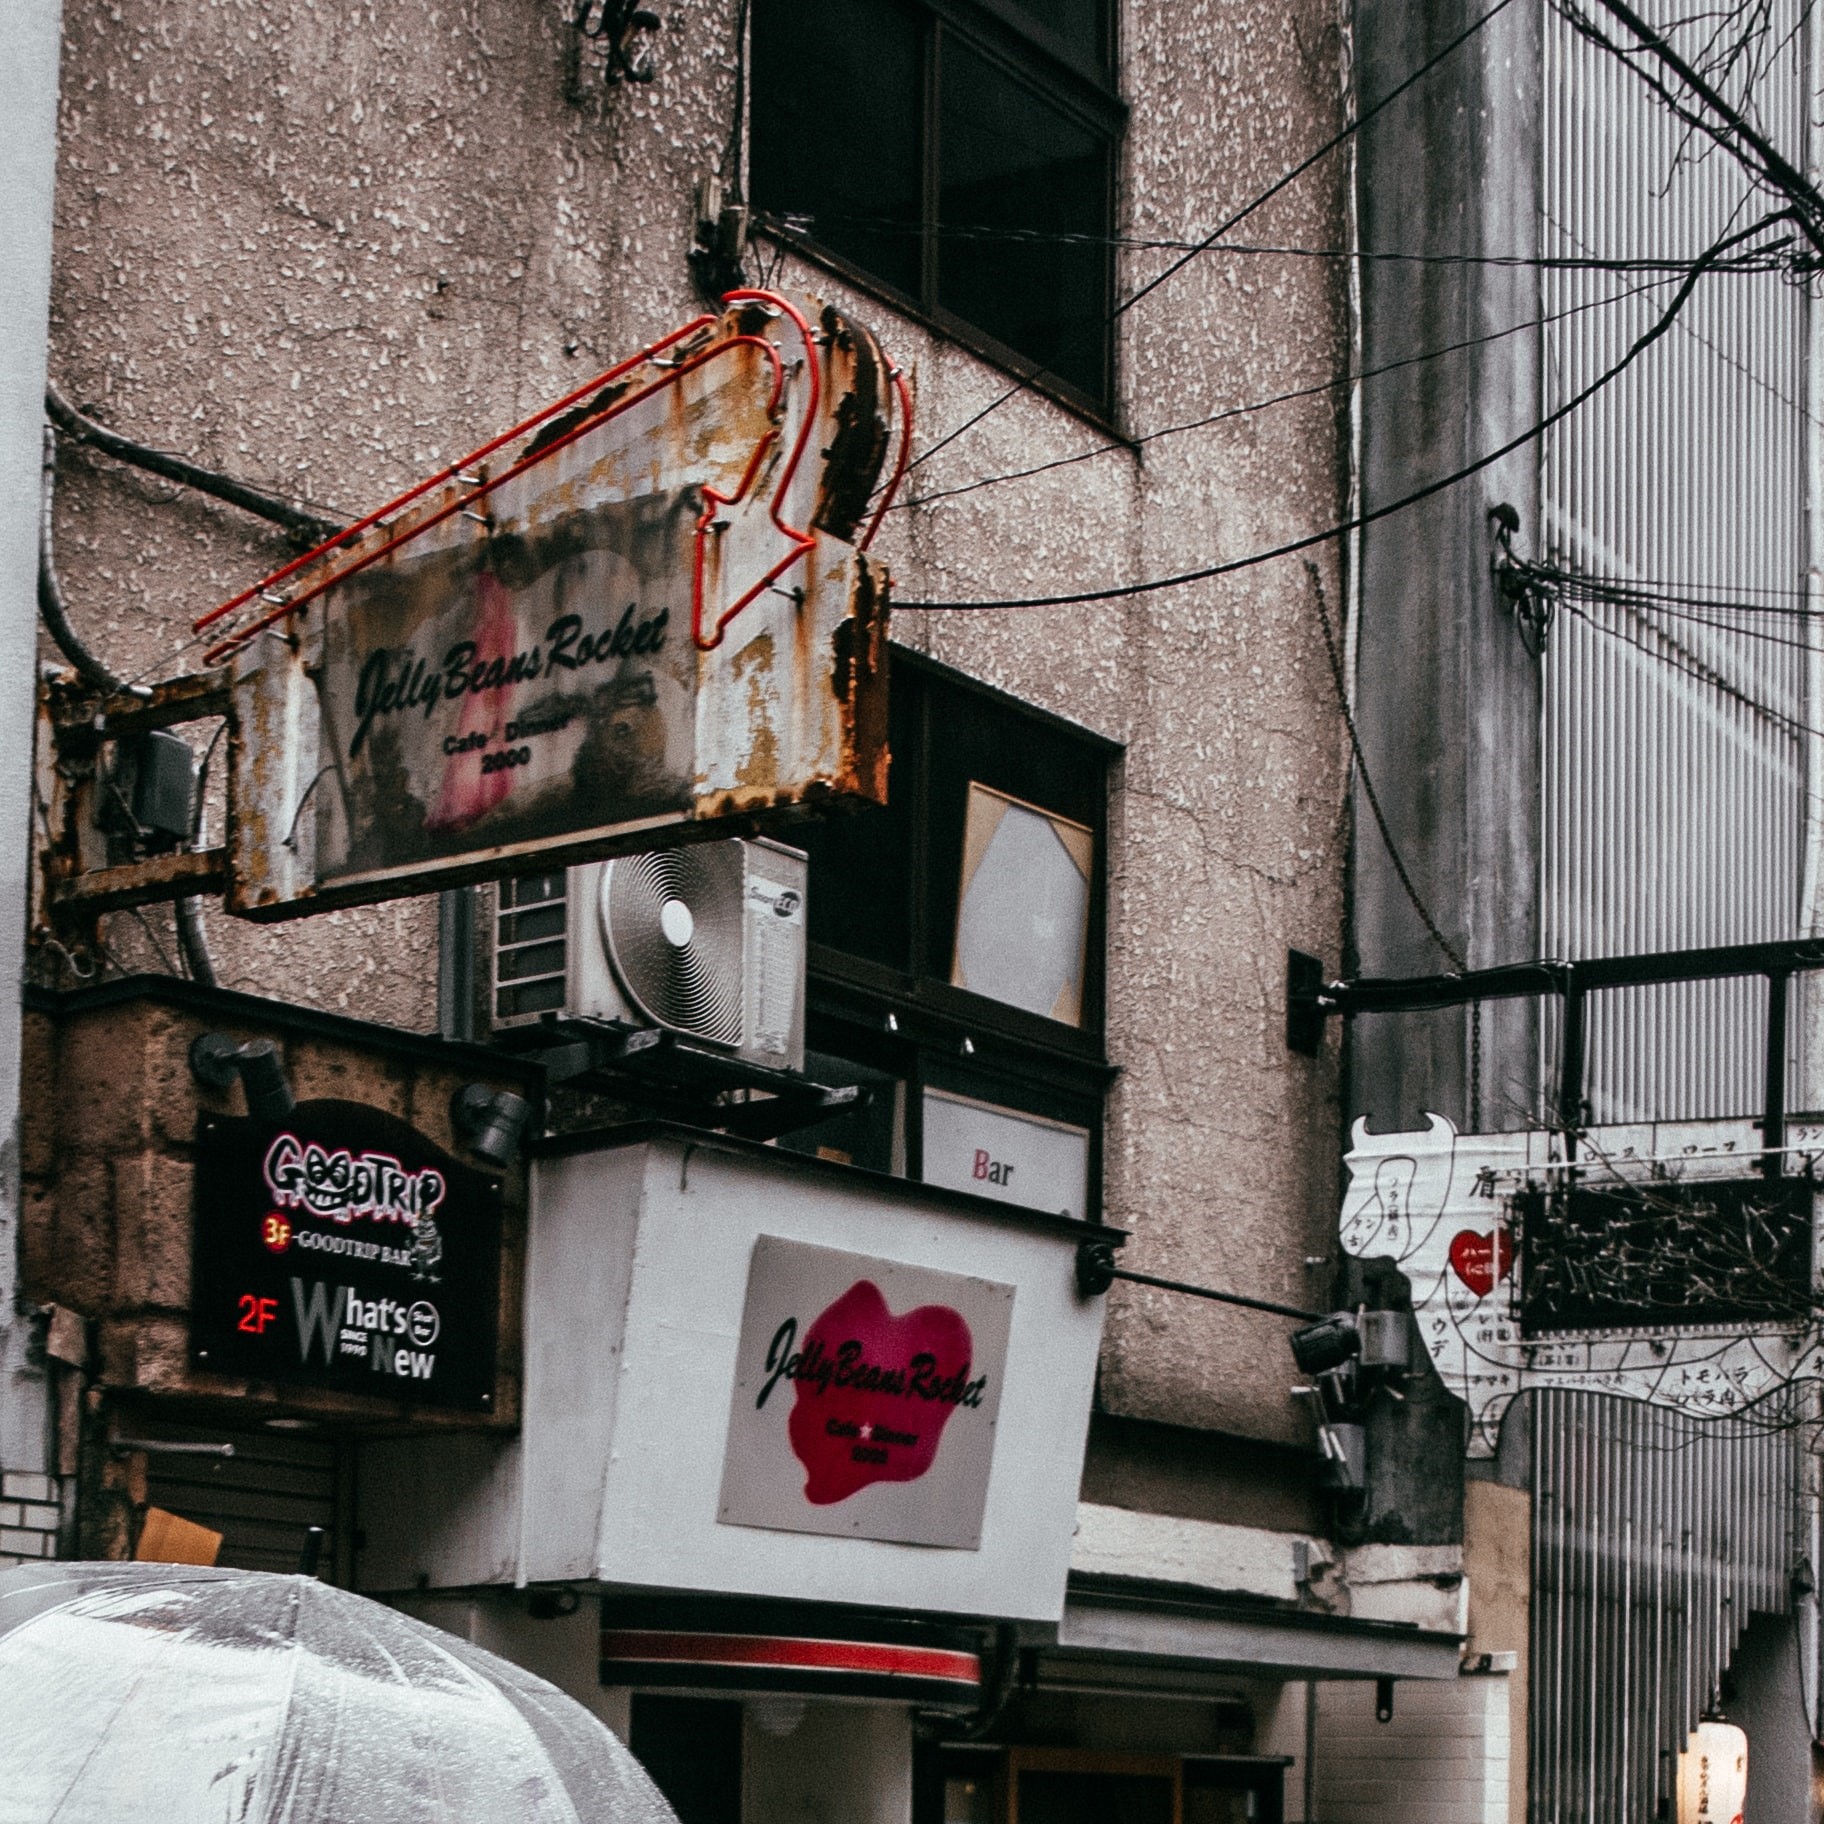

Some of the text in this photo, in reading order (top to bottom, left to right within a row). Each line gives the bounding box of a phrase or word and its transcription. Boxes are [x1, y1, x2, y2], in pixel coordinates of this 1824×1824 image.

[972, 1148, 1014, 1186] Bar
[264, 1217, 291, 1245] 3F
[237, 1293, 278, 1334] 2F
[372, 1335, 436, 1380] New
